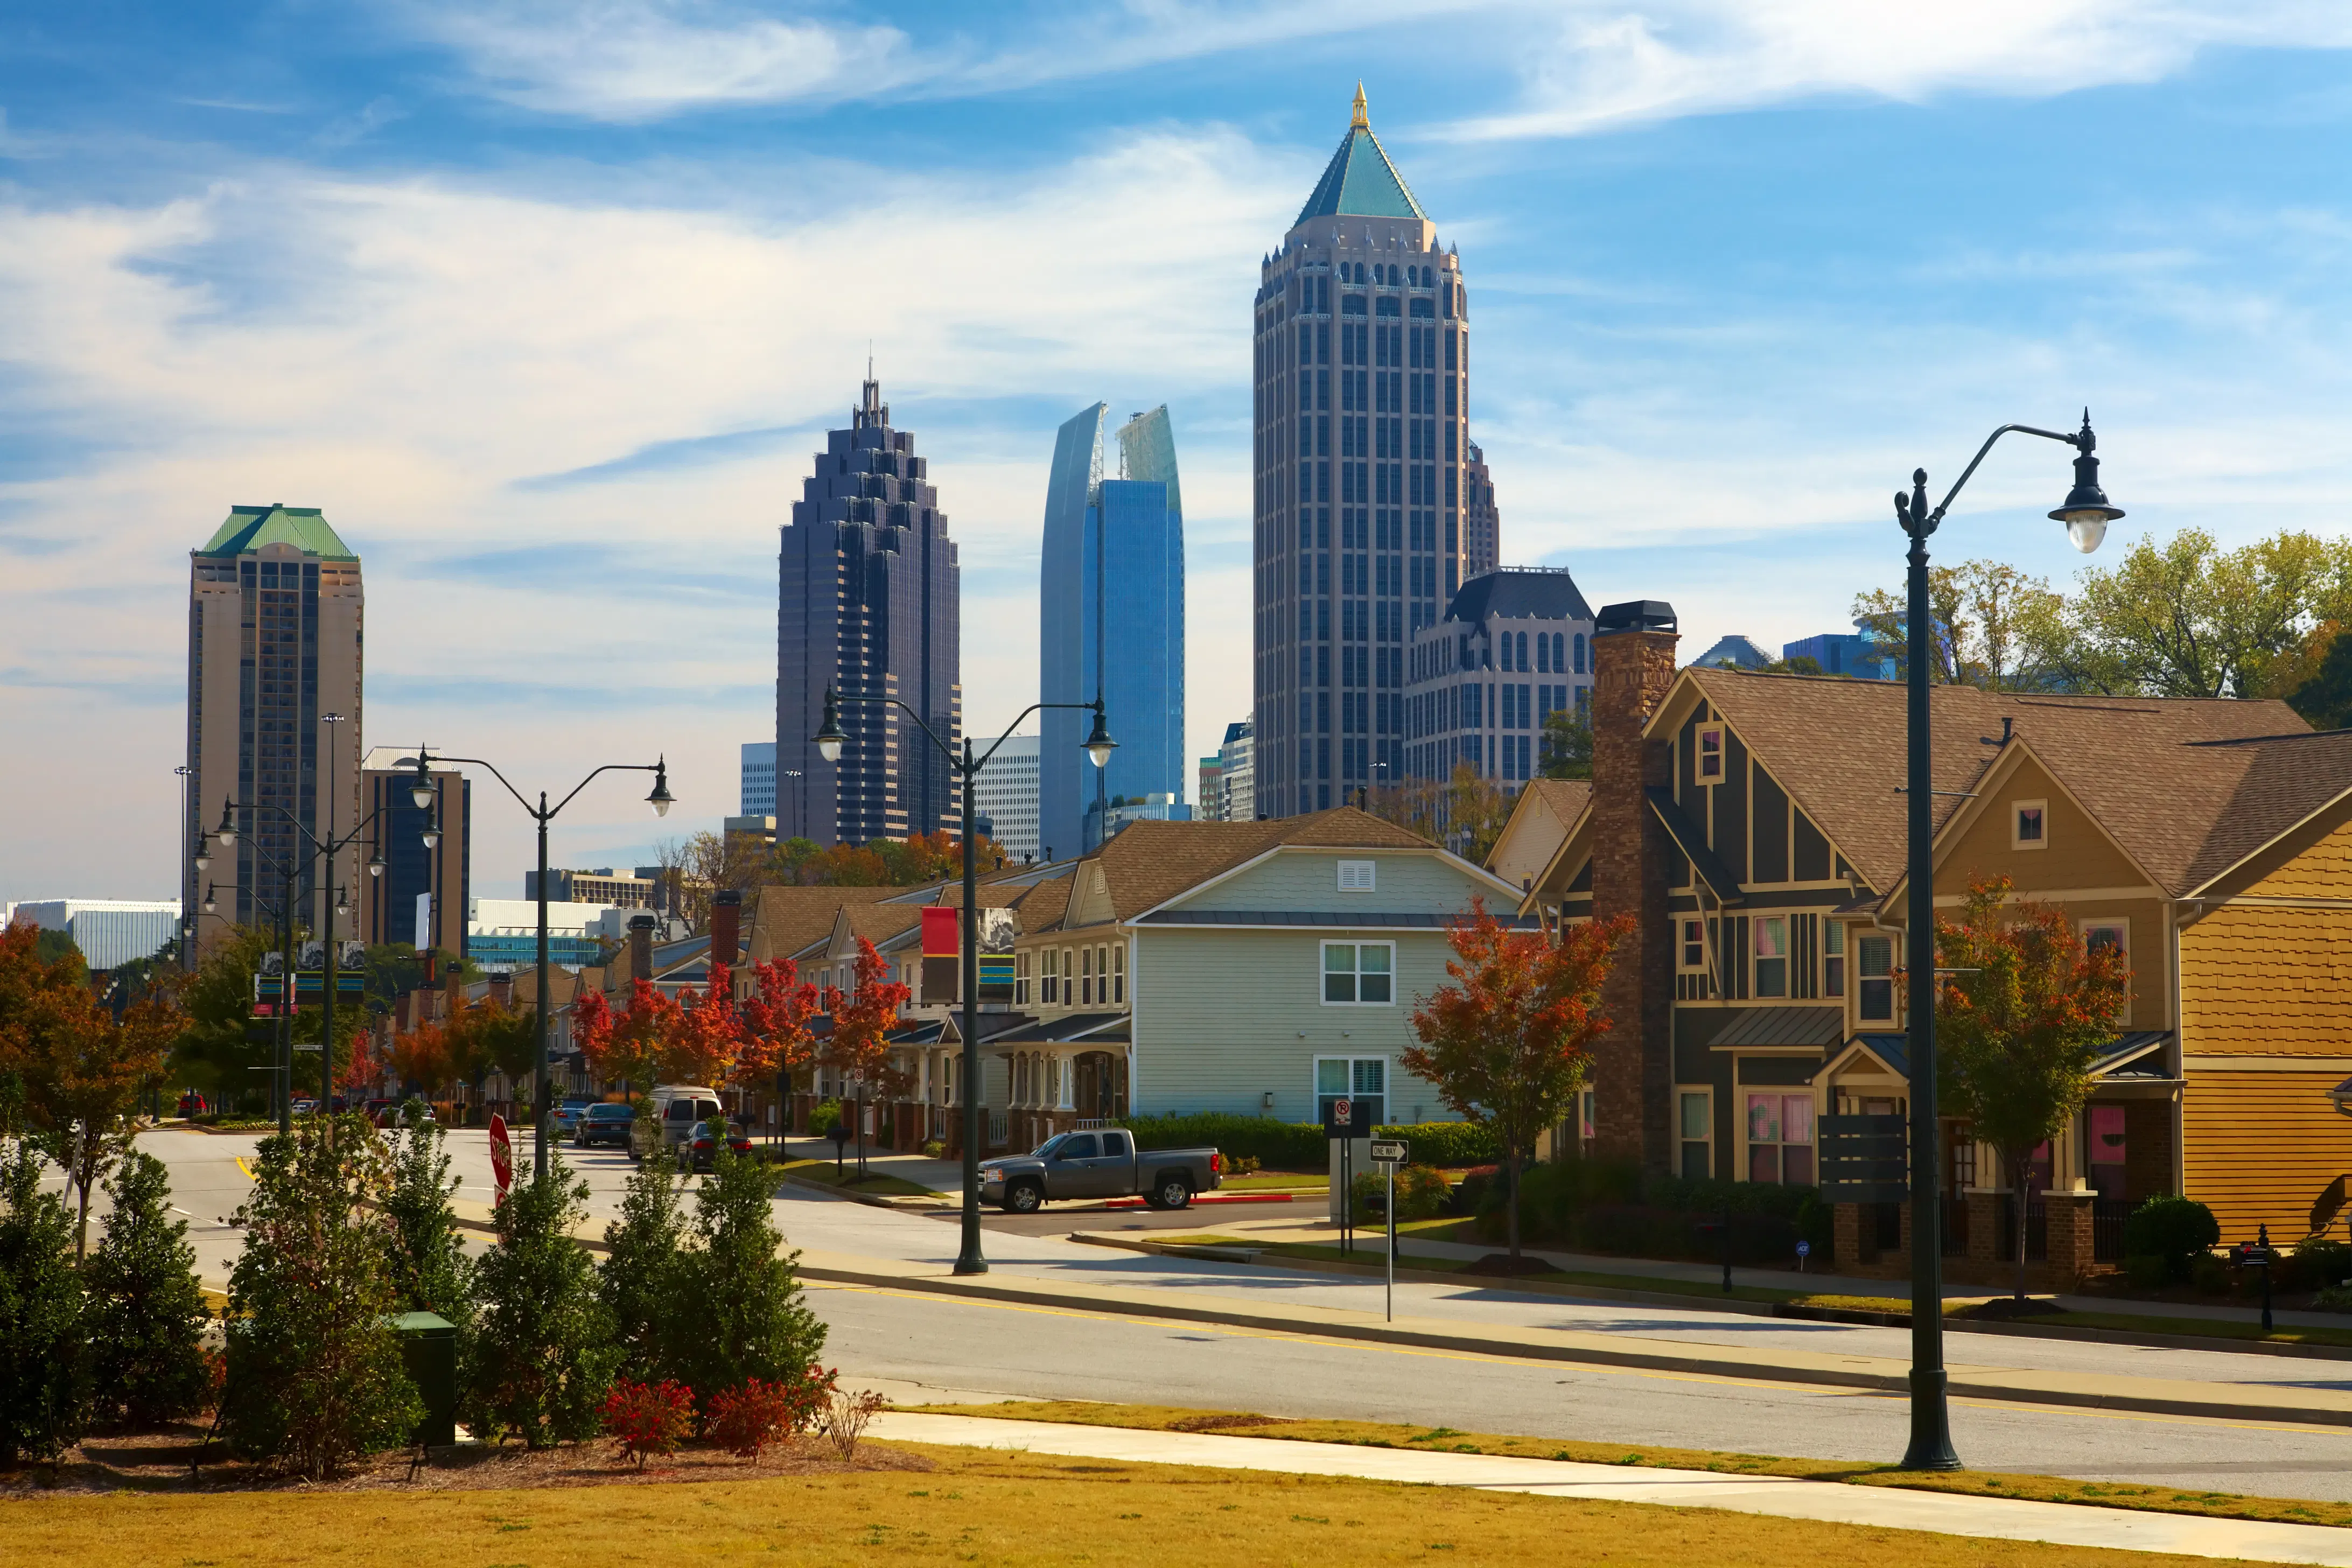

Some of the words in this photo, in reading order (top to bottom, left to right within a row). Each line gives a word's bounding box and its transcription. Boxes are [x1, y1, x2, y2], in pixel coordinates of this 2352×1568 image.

[491, 1134, 510, 1169] STOP
[1374, 1146, 1384, 1156] ONE
[1385, 1147, 1396, 1156] WAY
